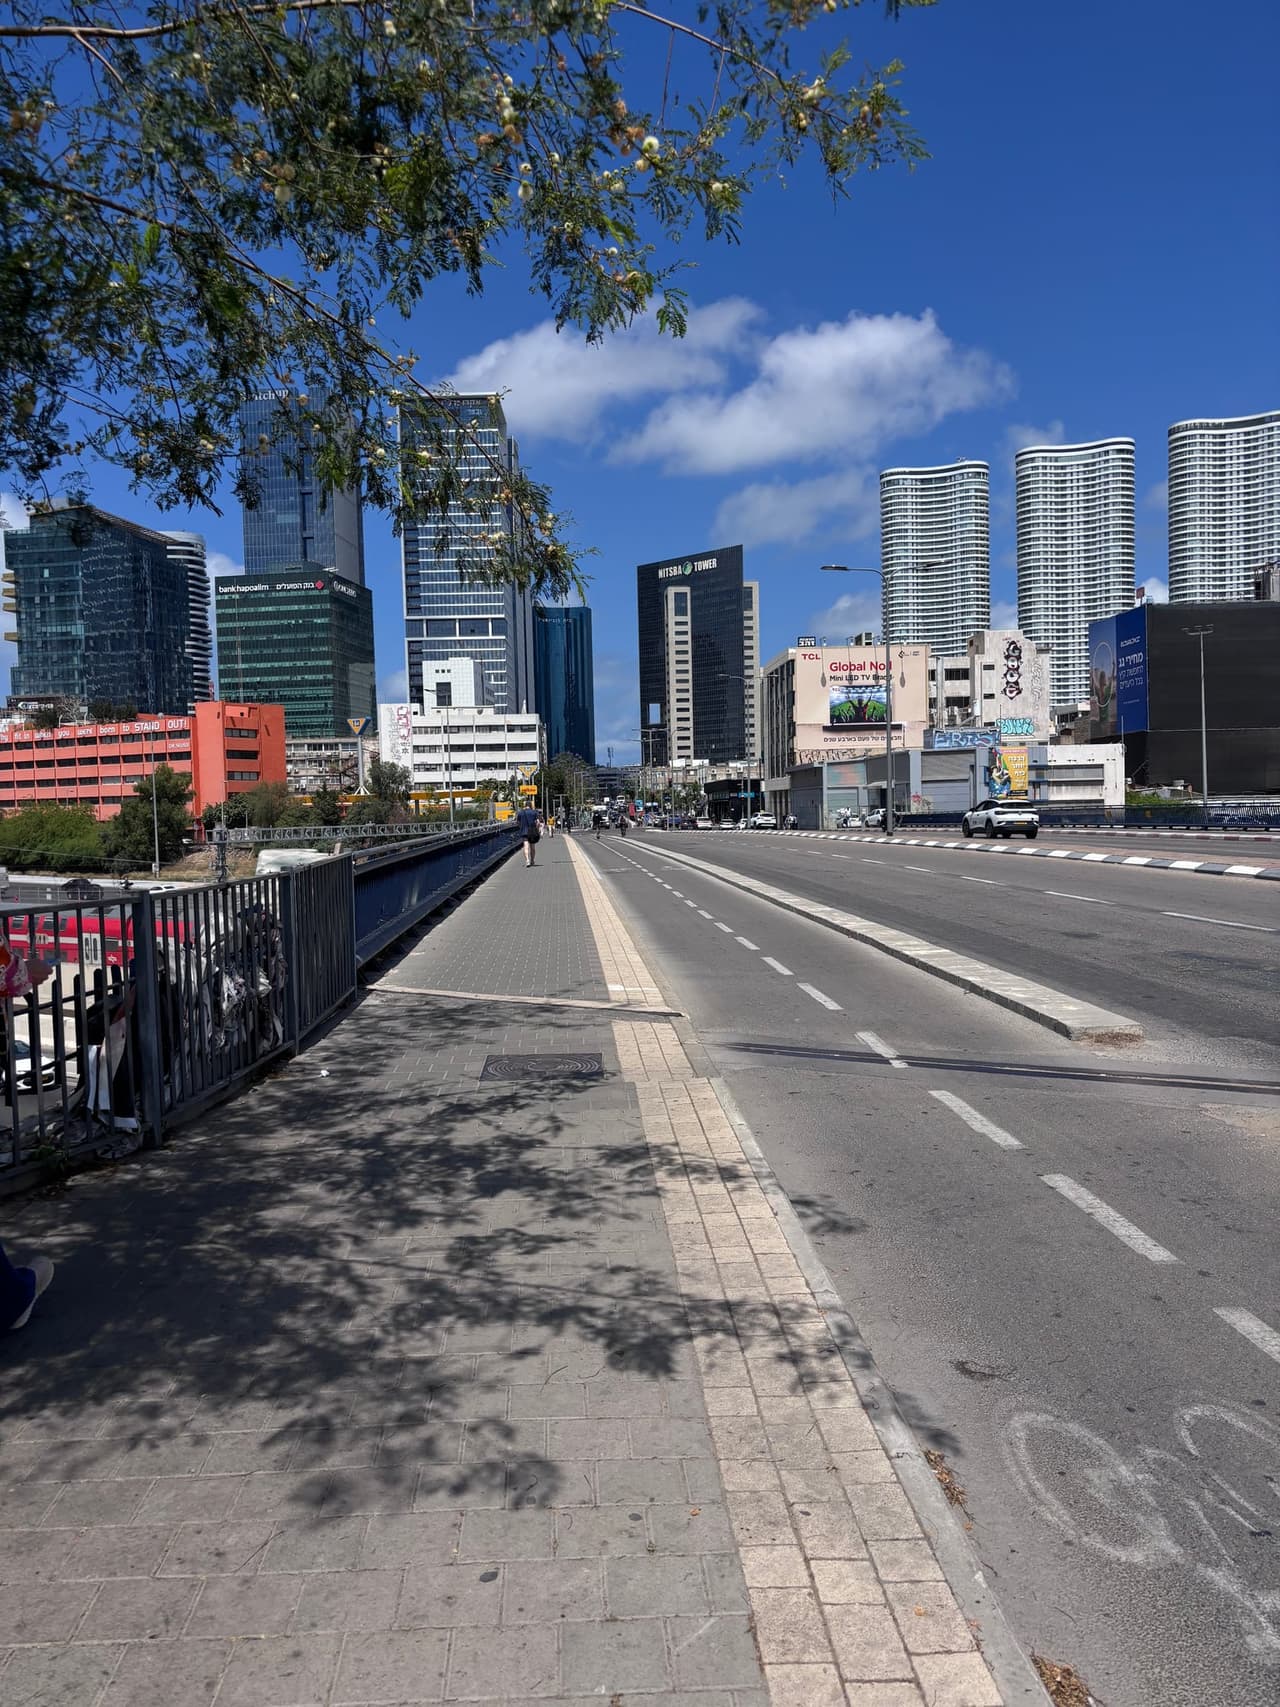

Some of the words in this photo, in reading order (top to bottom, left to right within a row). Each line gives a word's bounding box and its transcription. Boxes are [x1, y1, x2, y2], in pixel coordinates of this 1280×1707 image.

[658, 564, 683, 579] NITSBA
[693, 558, 717, 572] TOWER
[218, 585, 237, 593] bank
[237, 584, 269, 592] hapoalim
[829, 661, 866, 672] Global
[829, 674, 844, 682] Mini
[134, 721, 160, 732] STAND
[167, 719, 188, 729] OUT!
